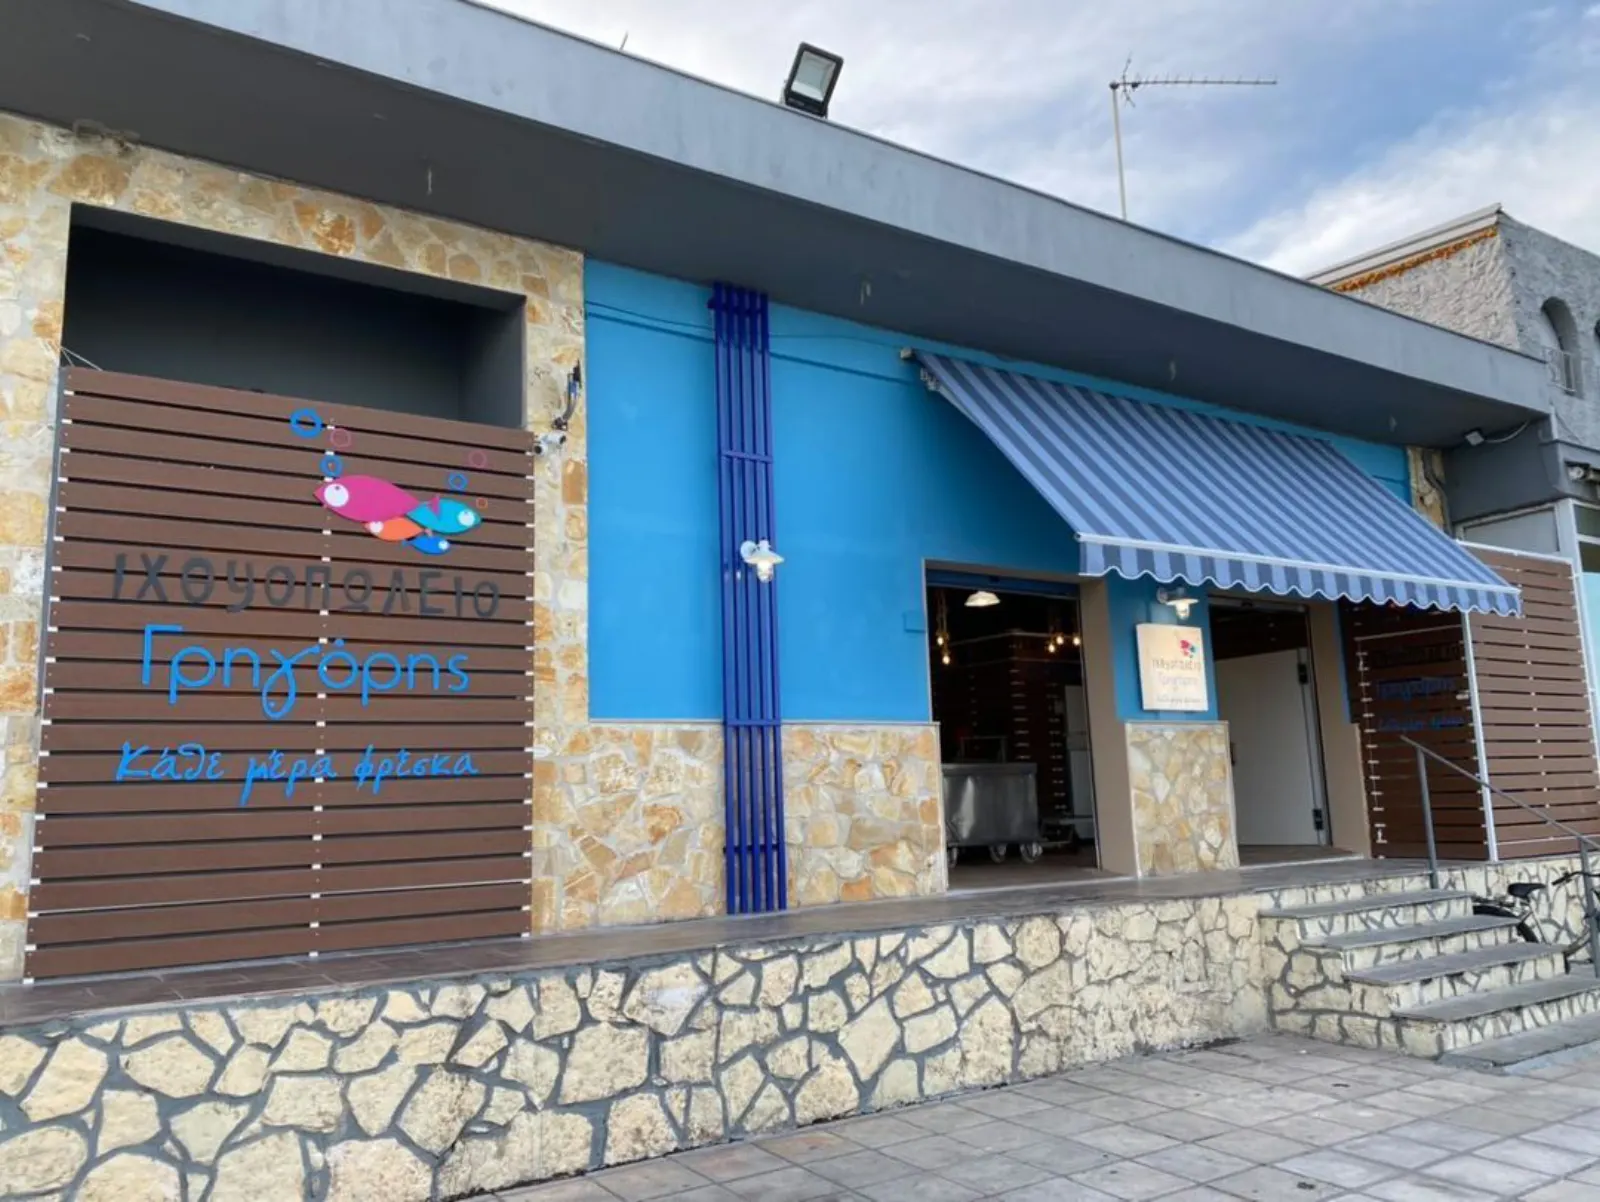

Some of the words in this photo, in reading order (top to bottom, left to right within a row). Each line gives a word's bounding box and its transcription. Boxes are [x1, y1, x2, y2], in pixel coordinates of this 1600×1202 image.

[141, 624, 471, 719] Γρηγόρης
[116, 741, 226, 783] Κάθε
[239, 749, 337, 807] μέρα
[353, 744, 479, 794] φρέσκα
